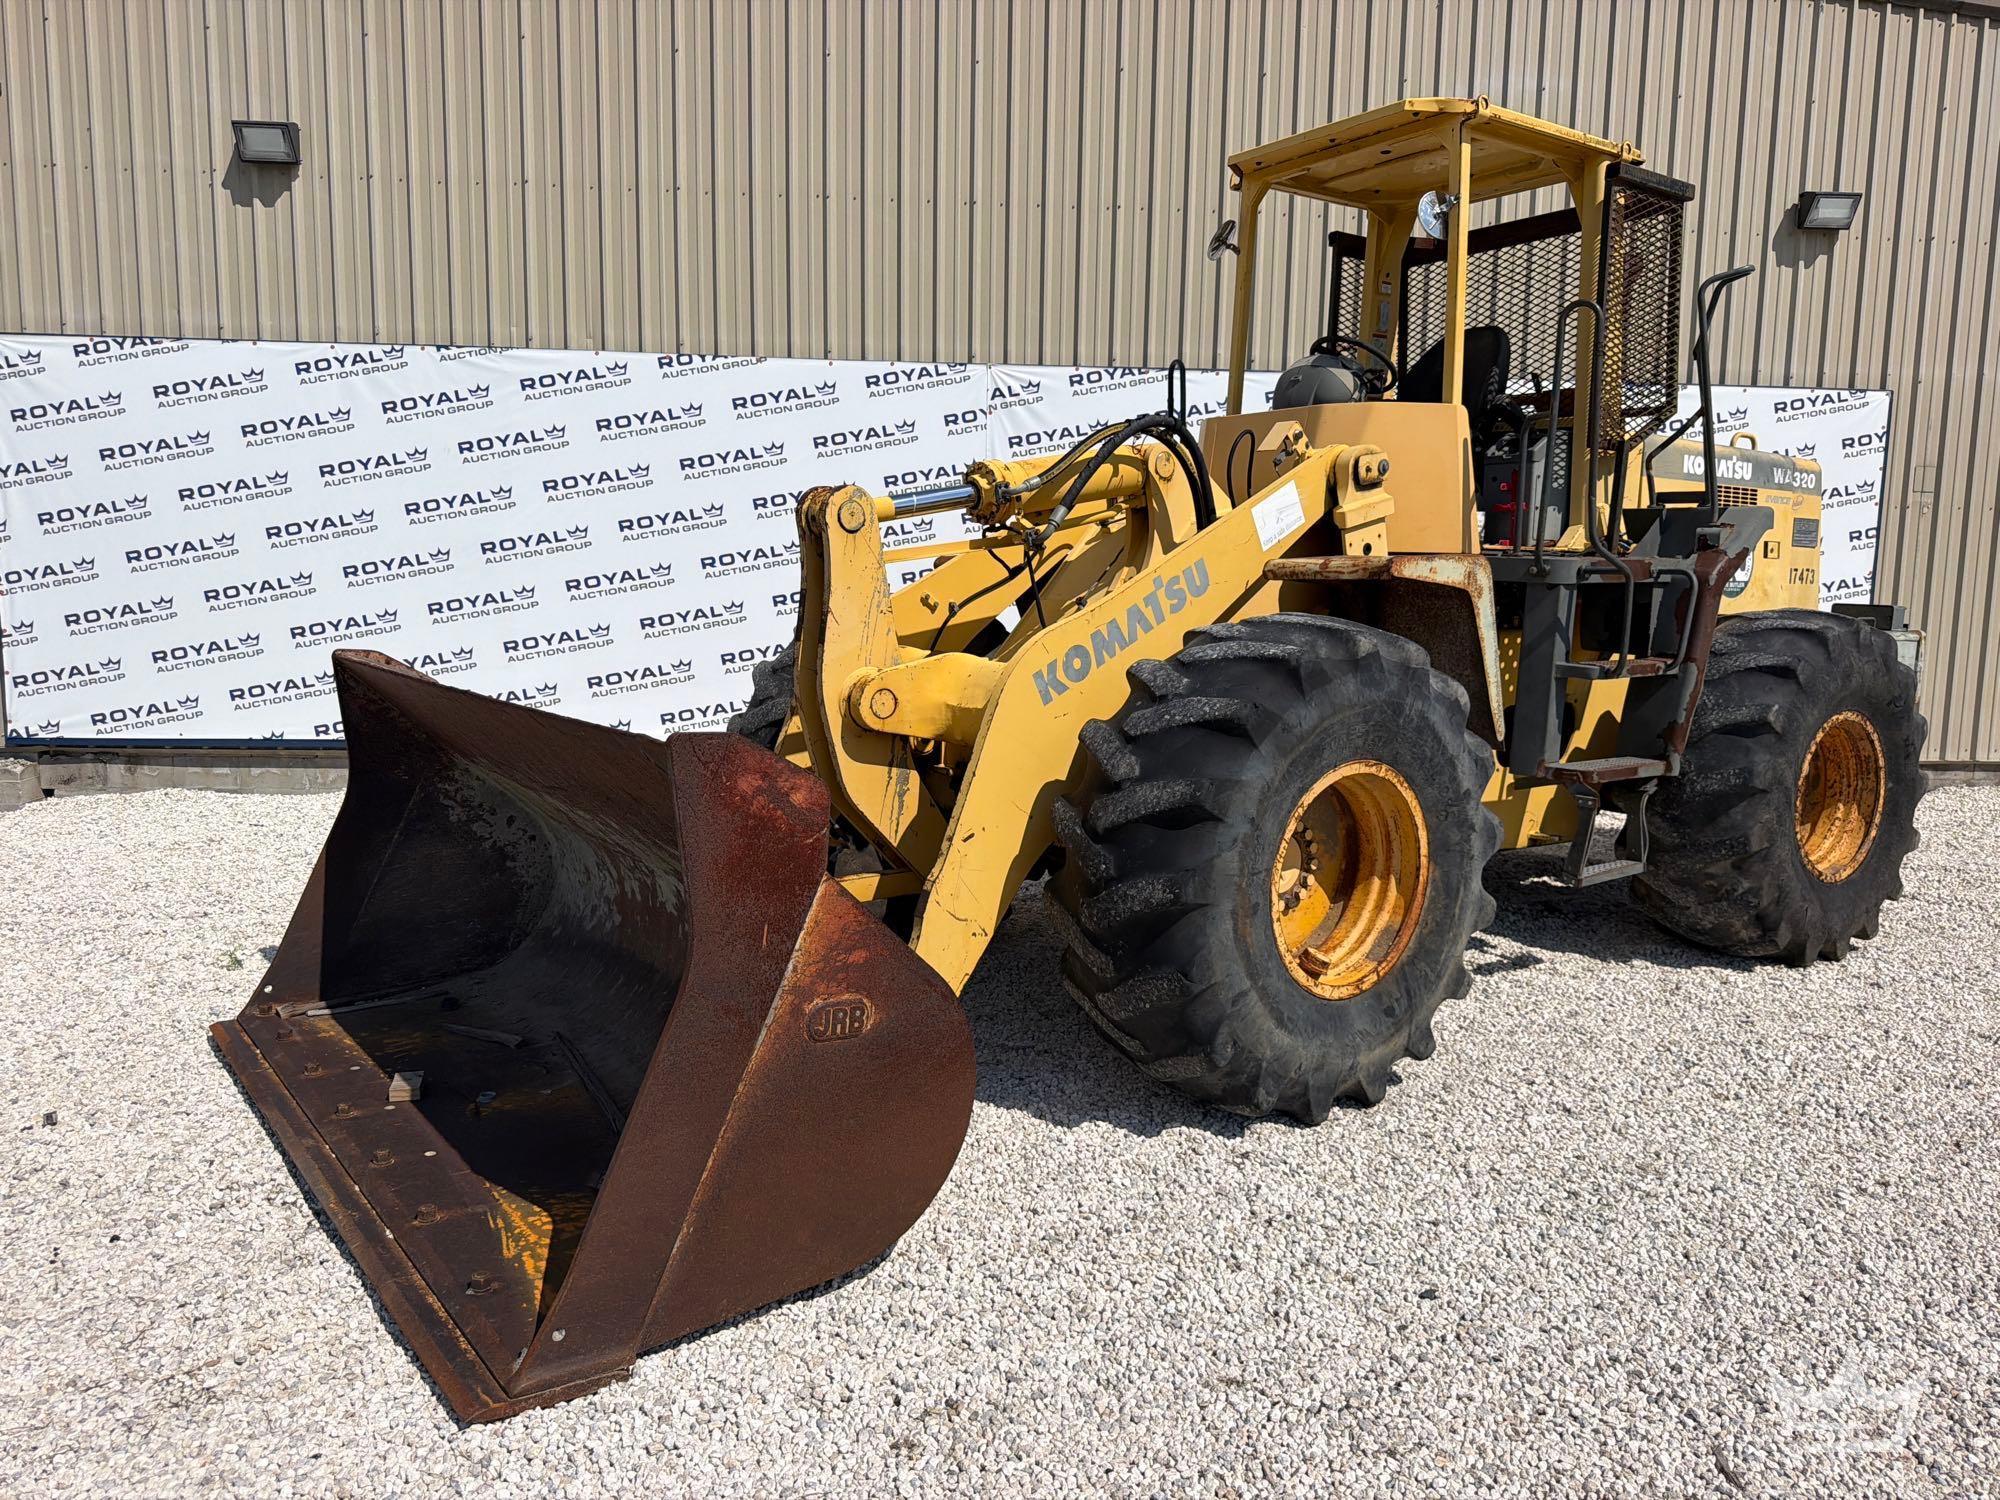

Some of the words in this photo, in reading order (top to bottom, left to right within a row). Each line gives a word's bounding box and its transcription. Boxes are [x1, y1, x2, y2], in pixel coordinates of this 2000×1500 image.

[78, 352, 139, 367] AUCTION
[141, 344, 189, 357] GROUP
[295, 351, 383, 375] ROYAL
[439, 348, 498, 362] AUCTION
[300, 370, 359, 385] AUCTION
[362, 361, 409, 375] GROUP
[520, 367, 606, 391] ROYAL
[662, 364, 719, 379] AUCTION
[722, 356, 767, 370] GROUP
[864, 365, 948, 388] ROYAL
[152, 374, 242, 398] ROYAL
[158, 393, 218, 408] AUCTION
[220, 384, 268, 398] GROUP
[525, 386, 583, 401] AUCTION
[585, 378, 631, 391] GROUP
[868, 383, 925, 398] AUCTION
[927, 375, 972, 388] GROUP
[1072, 384, 1126, 397] AUCTION
[9, 397, 100, 422] ROYAL
[381, 390, 468, 414] ROYAL
[731, 387, 816, 411] ROYAL
[736, 405, 793, 420] AUCTION
[795, 397, 840, 410] GROUP
[1000, 396, 1044, 410] GROUP
[1774, 392, 1848, 414] ROYAL
[15, 416, 76, 432] AUCTION
[78, 408, 126, 422] GROUP
[386, 408, 445, 424] AUCTION
[447, 400, 494, 414] GROUP
[596, 408, 681, 432] ROYAL
[1776, 408, 1826, 423] AUCTION
[1829, 402, 1870, 414] GROUP
[241, 413, 329, 438] ROYAL
[246, 432, 305, 447] AUCTION
[308, 424, 355, 437] GROUP
[601, 426, 658, 442] AUCTION
[660, 418, 706, 432] GROUP
[812, 425, 896, 449] ROYAL
[1008, 426, 1088, 448] ROYAL
[99, 436, 188, 461] ROYAL
[458, 430, 544, 455] ROYAL
[463, 449, 521, 464] AUCTION
[523, 441, 569, 454] GROUP
[816, 443, 873, 458] AUCTION
[875, 435, 920, 449] GROUP
[1011, 442, 1066, 458] AUCTION
[1842, 431, 1887, 450] ROY
[104, 455, 164, 471] AUCTION
[167, 447, 214, 461] GROUP
[319, 453, 406, 478] ROYAL
[679, 447, 764, 471] ROYAL
[684, 466, 740, 481] AUCTION
[743, 457, 788, 471] GROUP
[25, 471, 73, 485] GROUP
[324, 472, 383, 487] AUCTION
[385, 463, 432, 477] GROUP
[543, 469, 628, 493] ROYAL
[884, 464, 964, 488] ROYAL
[178, 477, 267, 501] ROYAL
[184, 496, 243, 511] AUCTION
[245, 487, 292, 501] GROUP
[548, 487, 605, 503] AUCTION
[607, 479, 653, 493] GROUP
[752, 491, 803, 510] ROY
[37, 501, 126, 526] ROYAL
[404, 491, 491, 516] ROYAL
[409, 510, 467, 525] AUCTION
[470, 502, 516, 515] GROUP
[1836, 495, 1876, 508] GROUP
[42, 520, 102, 535] AUCTION
[105, 511, 152, 525] GROUP
[265, 515, 353, 539] ROYAL
[618, 509, 703, 533] ROYAL
[623, 527, 679, 542] AUCTION
[682, 519, 727, 532] GROUP
[270, 533, 329, 549] AUCTION
[332, 525, 378, 539] GROUP
[481, 531, 566, 555] ROYAL
[892, 534, 936, 546] GROUP
[125, 539, 214, 564] ROYAL
[130, 557, 190, 573] AUCTION
[192, 549, 239, 563] GROUP
[486, 549, 543, 565] AUCTION
[546, 541, 591, 554] GROUP
[700, 546, 784, 570] ROYAL
[0, 563, 74, 588] OYAL
[342, 554, 429, 578] ROYAL
[347, 572, 406, 588] AUCTION
[408, 564, 454, 577] GROUP
[704, 564, 761, 579] AUCTION
[763, 557, 799, 569] GROU
[1789, 568, 1816, 584] 17473
[53, 573, 100, 587] GROUP
[203, 578, 291, 602] ROYAL
[566, 568, 650, 592] ROYAL
[570, 586, 627, 602] AUCTION
[630, 578, 675, 592] GROUP
[1822, 577, 1864, 593] YAL
[209, 596, 268, 612] AUCTION
[270, 588, 317, 602] GROUP
[428, 591, 513, 615] ROYAL
[64, 602, 152, 627] ROYAL
[69, 620, 129, 636] AUCTION
[131, 612, 178, 626] GROUP
[433, 609, 490, 625] AUCTION
[493, 601, 538, 615] GROUP
[639, 606, 723, 630] ROYAL
[289, 614, 376, 639] ROYAL
[295, 633, 353, 648] AUCTION
[355, 624, 401, 638] GROUP
[644, 624, 700, 639] AUCTION
[703, 616, 748, 629] GROUP
[1032, 558, 1210, 706] KOMATSU
[0, 636, 38, 649] ROUP
[151, 639, 239, 664] ROYAL
[504, 629, 589, 653] ROYAL
[509, 647, 566, 663] AUCTION
[568, 639, 613, 653] GROUP
[157, 657, 215, 673] AUCTION
[218, 649, 265, 663] GROUP
[431, 662, 477, 676] GROUP
[12, 663, 101, 688] ROYAL
[17, 682, 77, 698] AUCTION
[79, 673, 126, 687] GROUP
[587, 665, 671, 689] ROYAL
[592, 683, 648, 698] AUCTION
[651, 674, 695, 688] GROUP
[229, 677, 316, 701] ROYAL
[90, 701, 178, 726] ROYAL
[234, 695, 292, 711] AUCTION
[660, 701, 742, 725] ROYAL
[96, 720, 154, 735] AUCTION
[157, 711, 204, 725] GROUP
[664, 717, 721, 734] AUCTION
[814, 1005, 866, 1037] JRB
